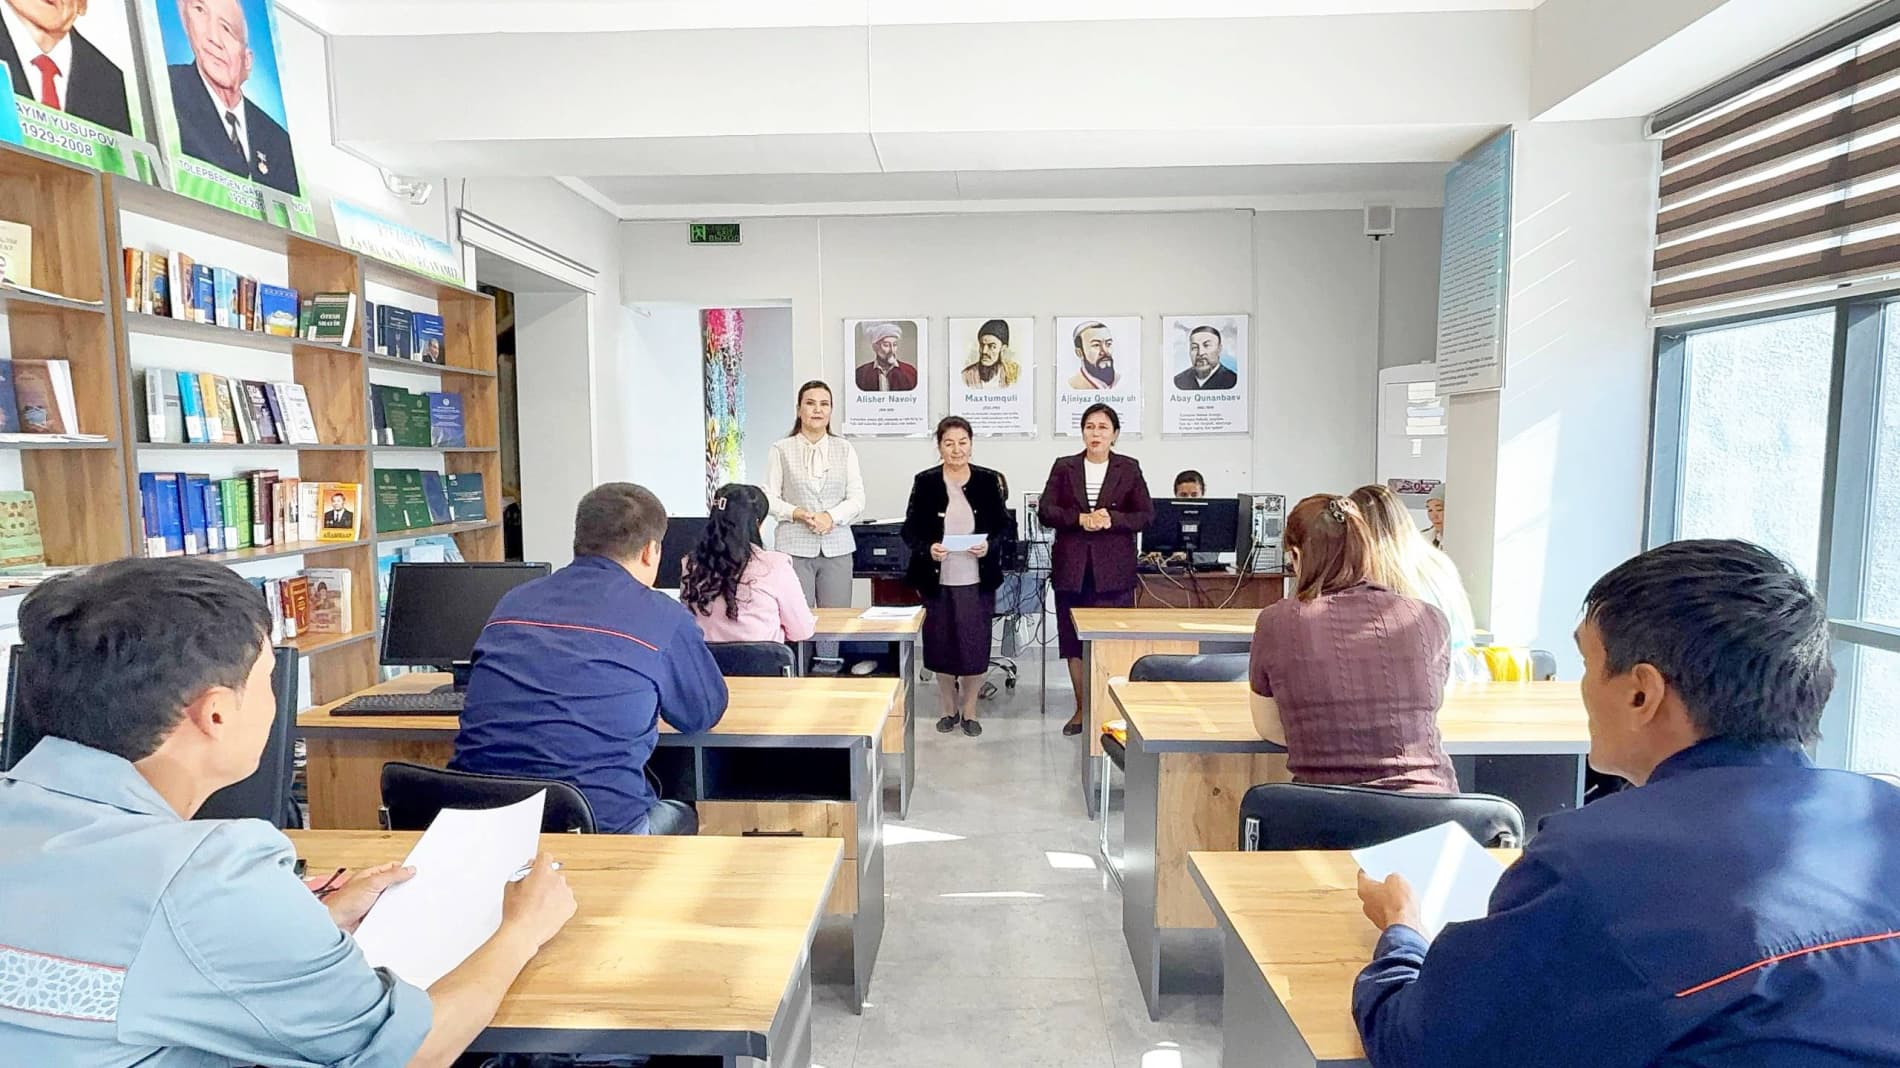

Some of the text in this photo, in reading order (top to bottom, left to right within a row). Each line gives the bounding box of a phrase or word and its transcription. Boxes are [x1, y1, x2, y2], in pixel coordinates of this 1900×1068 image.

[16, 101, 116, 147] AYIM YUSUPOV
[22, 122, 94, 157] 1929-2008
[856, 394, 918, 404] Alisher Navoiy
[1169, 394, 1192, 404] Abay
